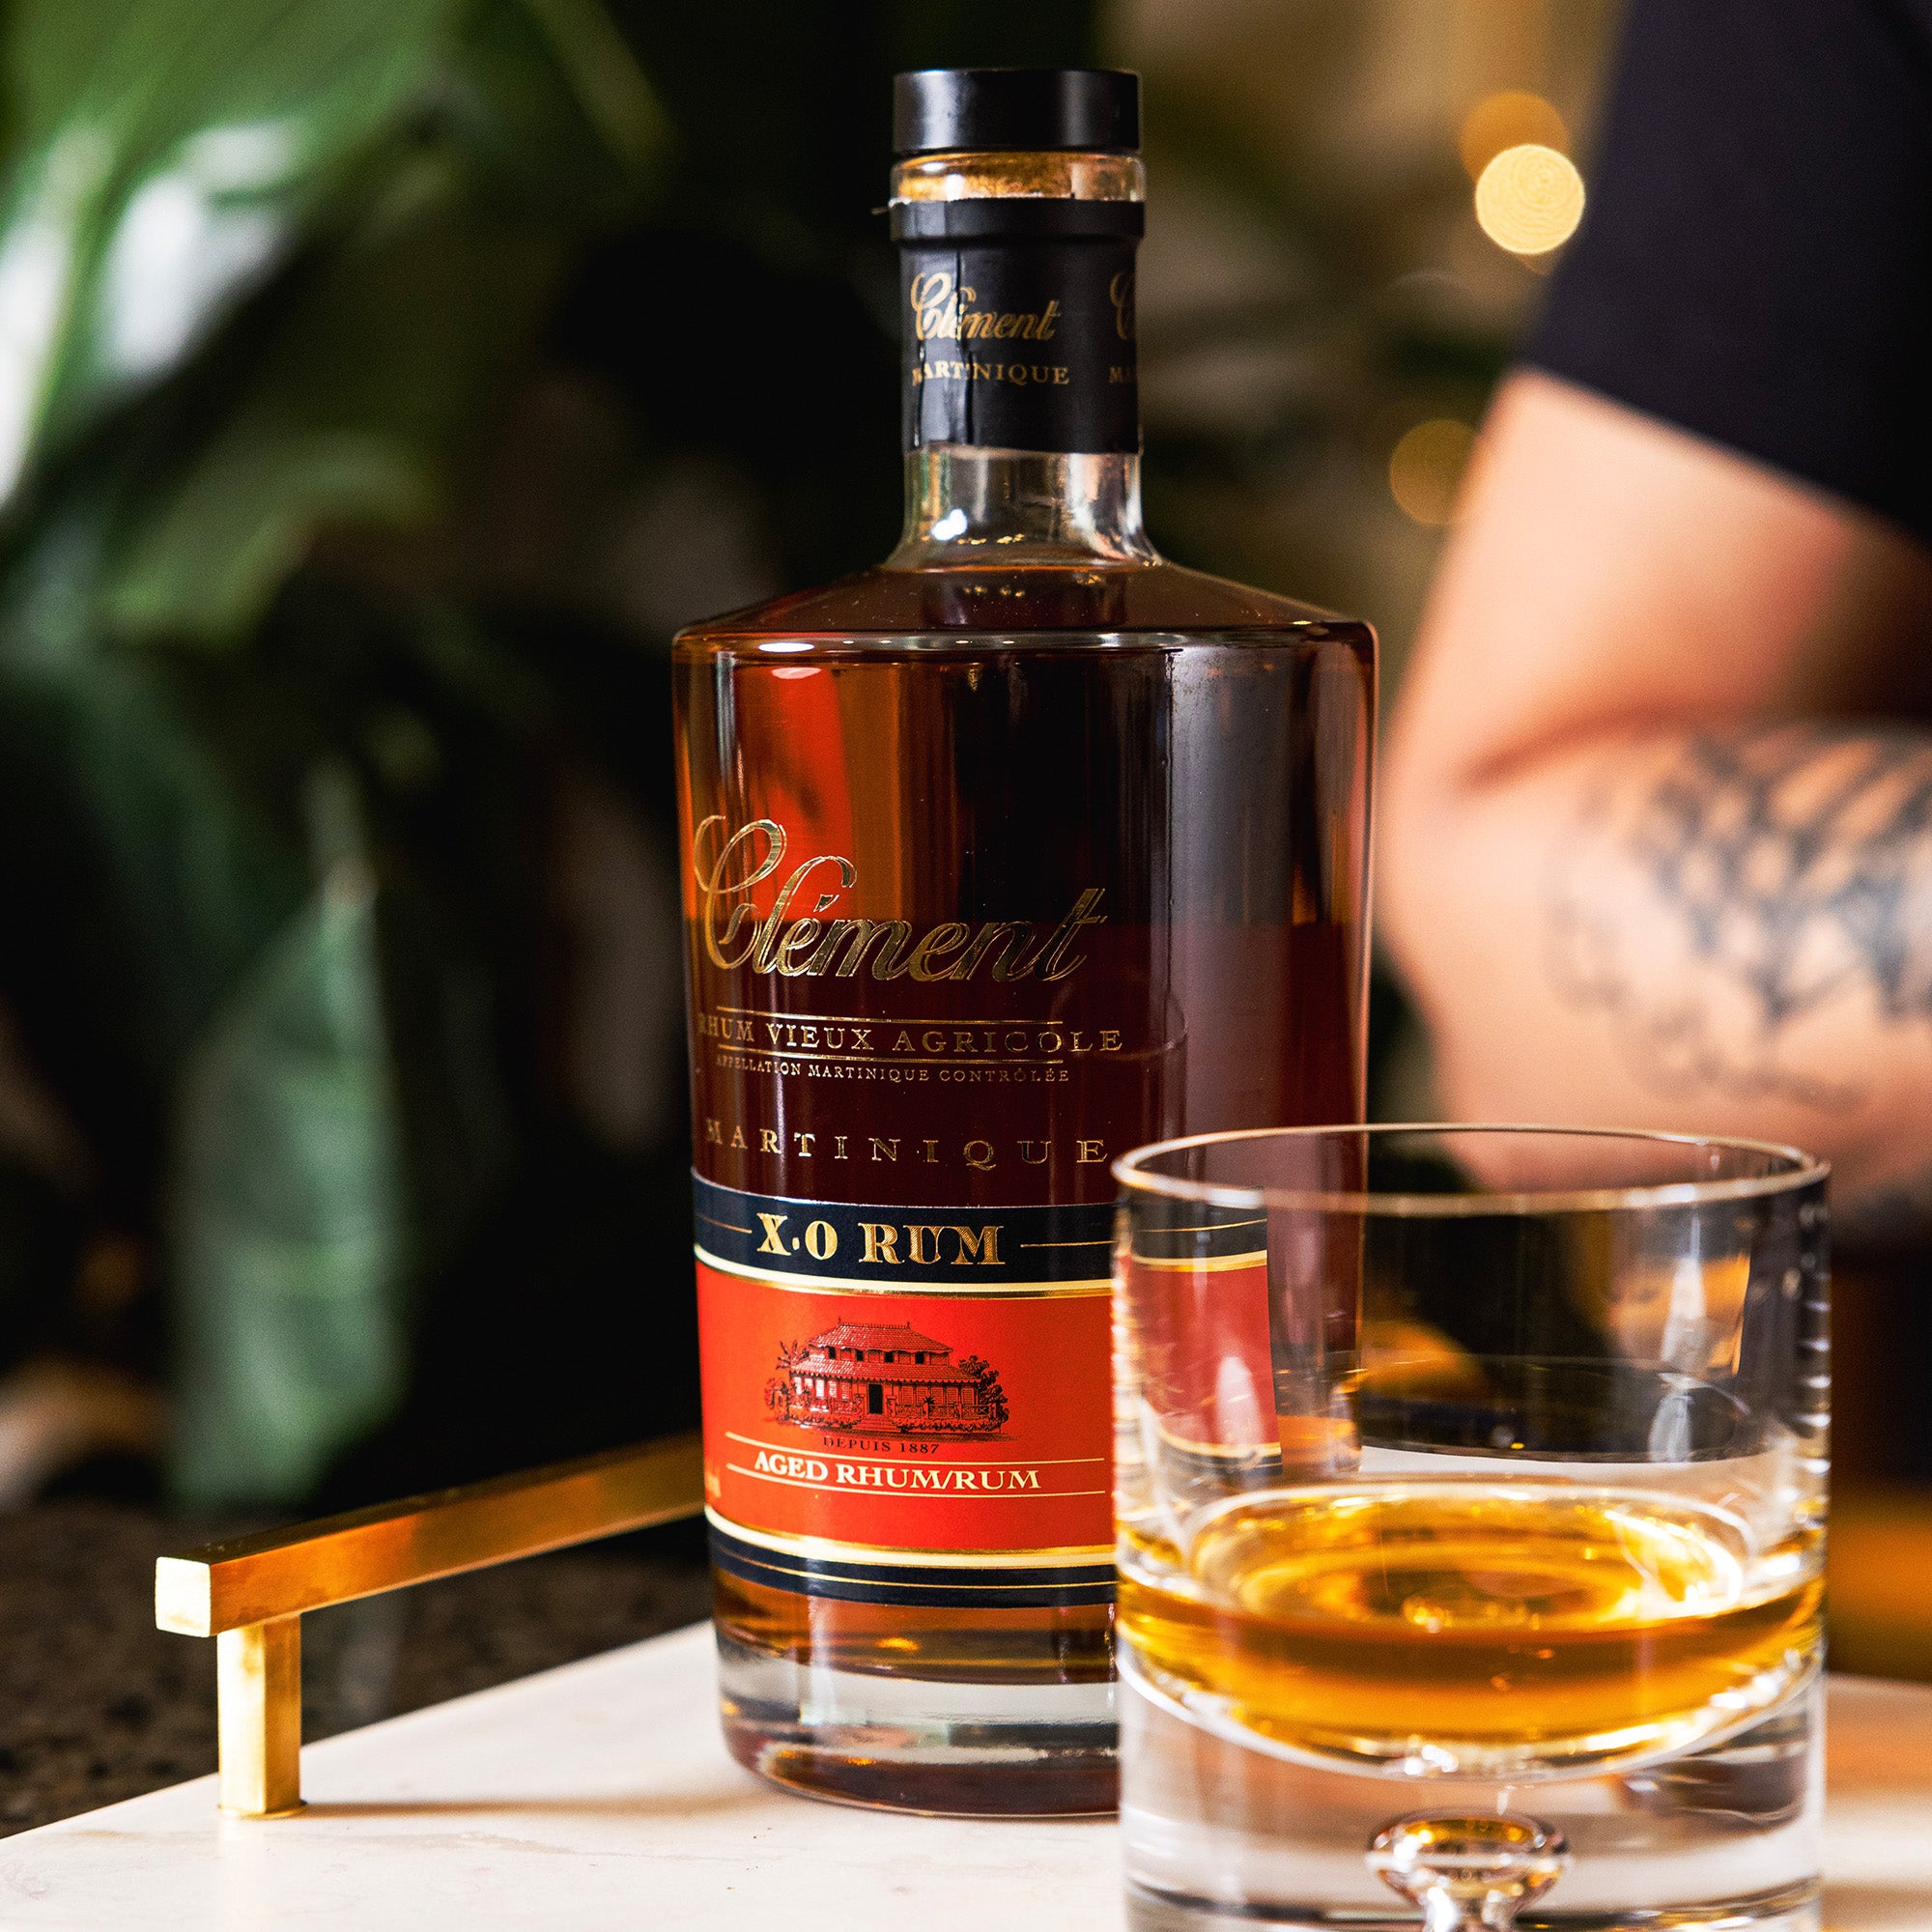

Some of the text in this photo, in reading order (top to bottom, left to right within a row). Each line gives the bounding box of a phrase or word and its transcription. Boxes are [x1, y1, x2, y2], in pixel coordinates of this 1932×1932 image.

[694, 814, 1108, 982] Clément
[766, 1022, 875, 1051] VIEUX
[892, 1029, 1123, 1054] AGRICOLE
[716, 1054, 802, 1077] APPELLATION
[808, 1063, 930, 1084] MARTINIQUE
[705, 1117, 1109, 1172] MARTINIQUE
[857, 1221, 1007, 1265] RUM
[822, 1435, 941, 1455] DEPUIS 1887
[753, 1450, 1042, 1491] AGED RHUM/RUM
